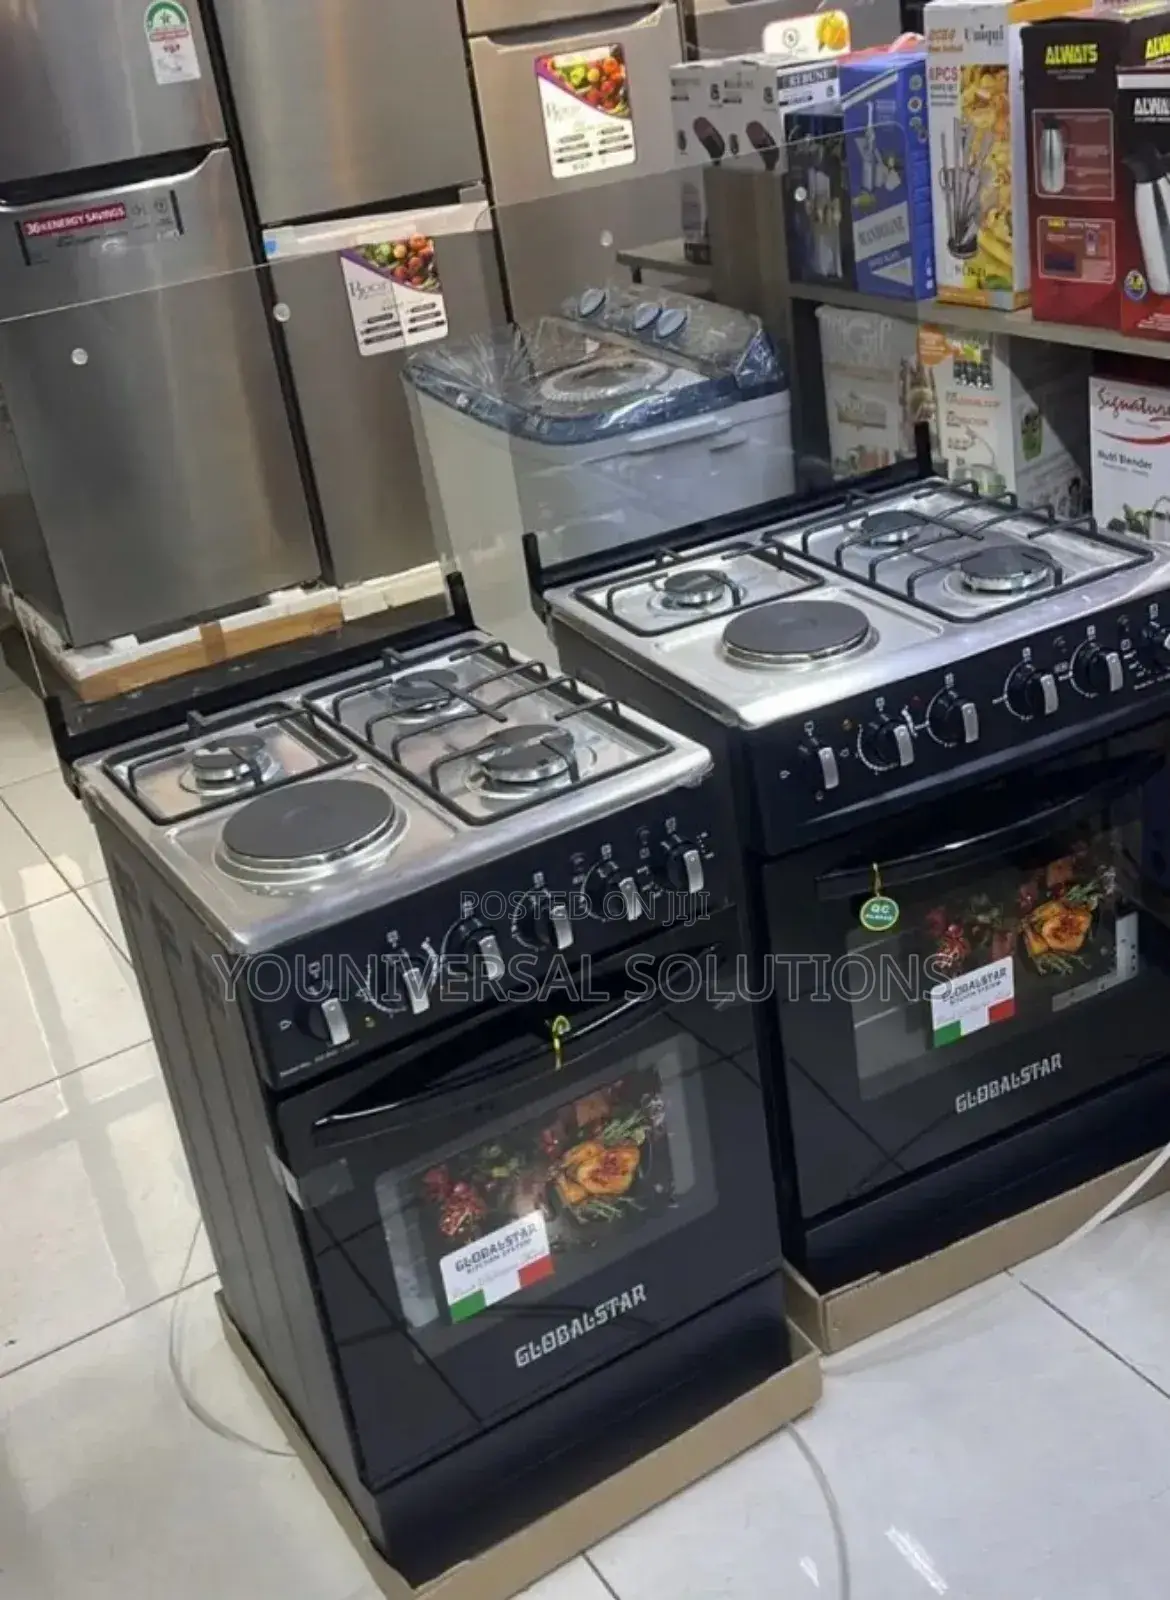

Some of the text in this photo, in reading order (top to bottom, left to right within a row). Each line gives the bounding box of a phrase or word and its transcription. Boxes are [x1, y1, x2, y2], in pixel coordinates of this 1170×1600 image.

[1045, 43, 1099, 65] ALWAYS
[954, 1052, 1063, 1114] GLOBALSTAR
[454, 1222, 538, 1273] GLOBALSTAR
[514, 1282, 648, 1369] GLOBALSTAR
